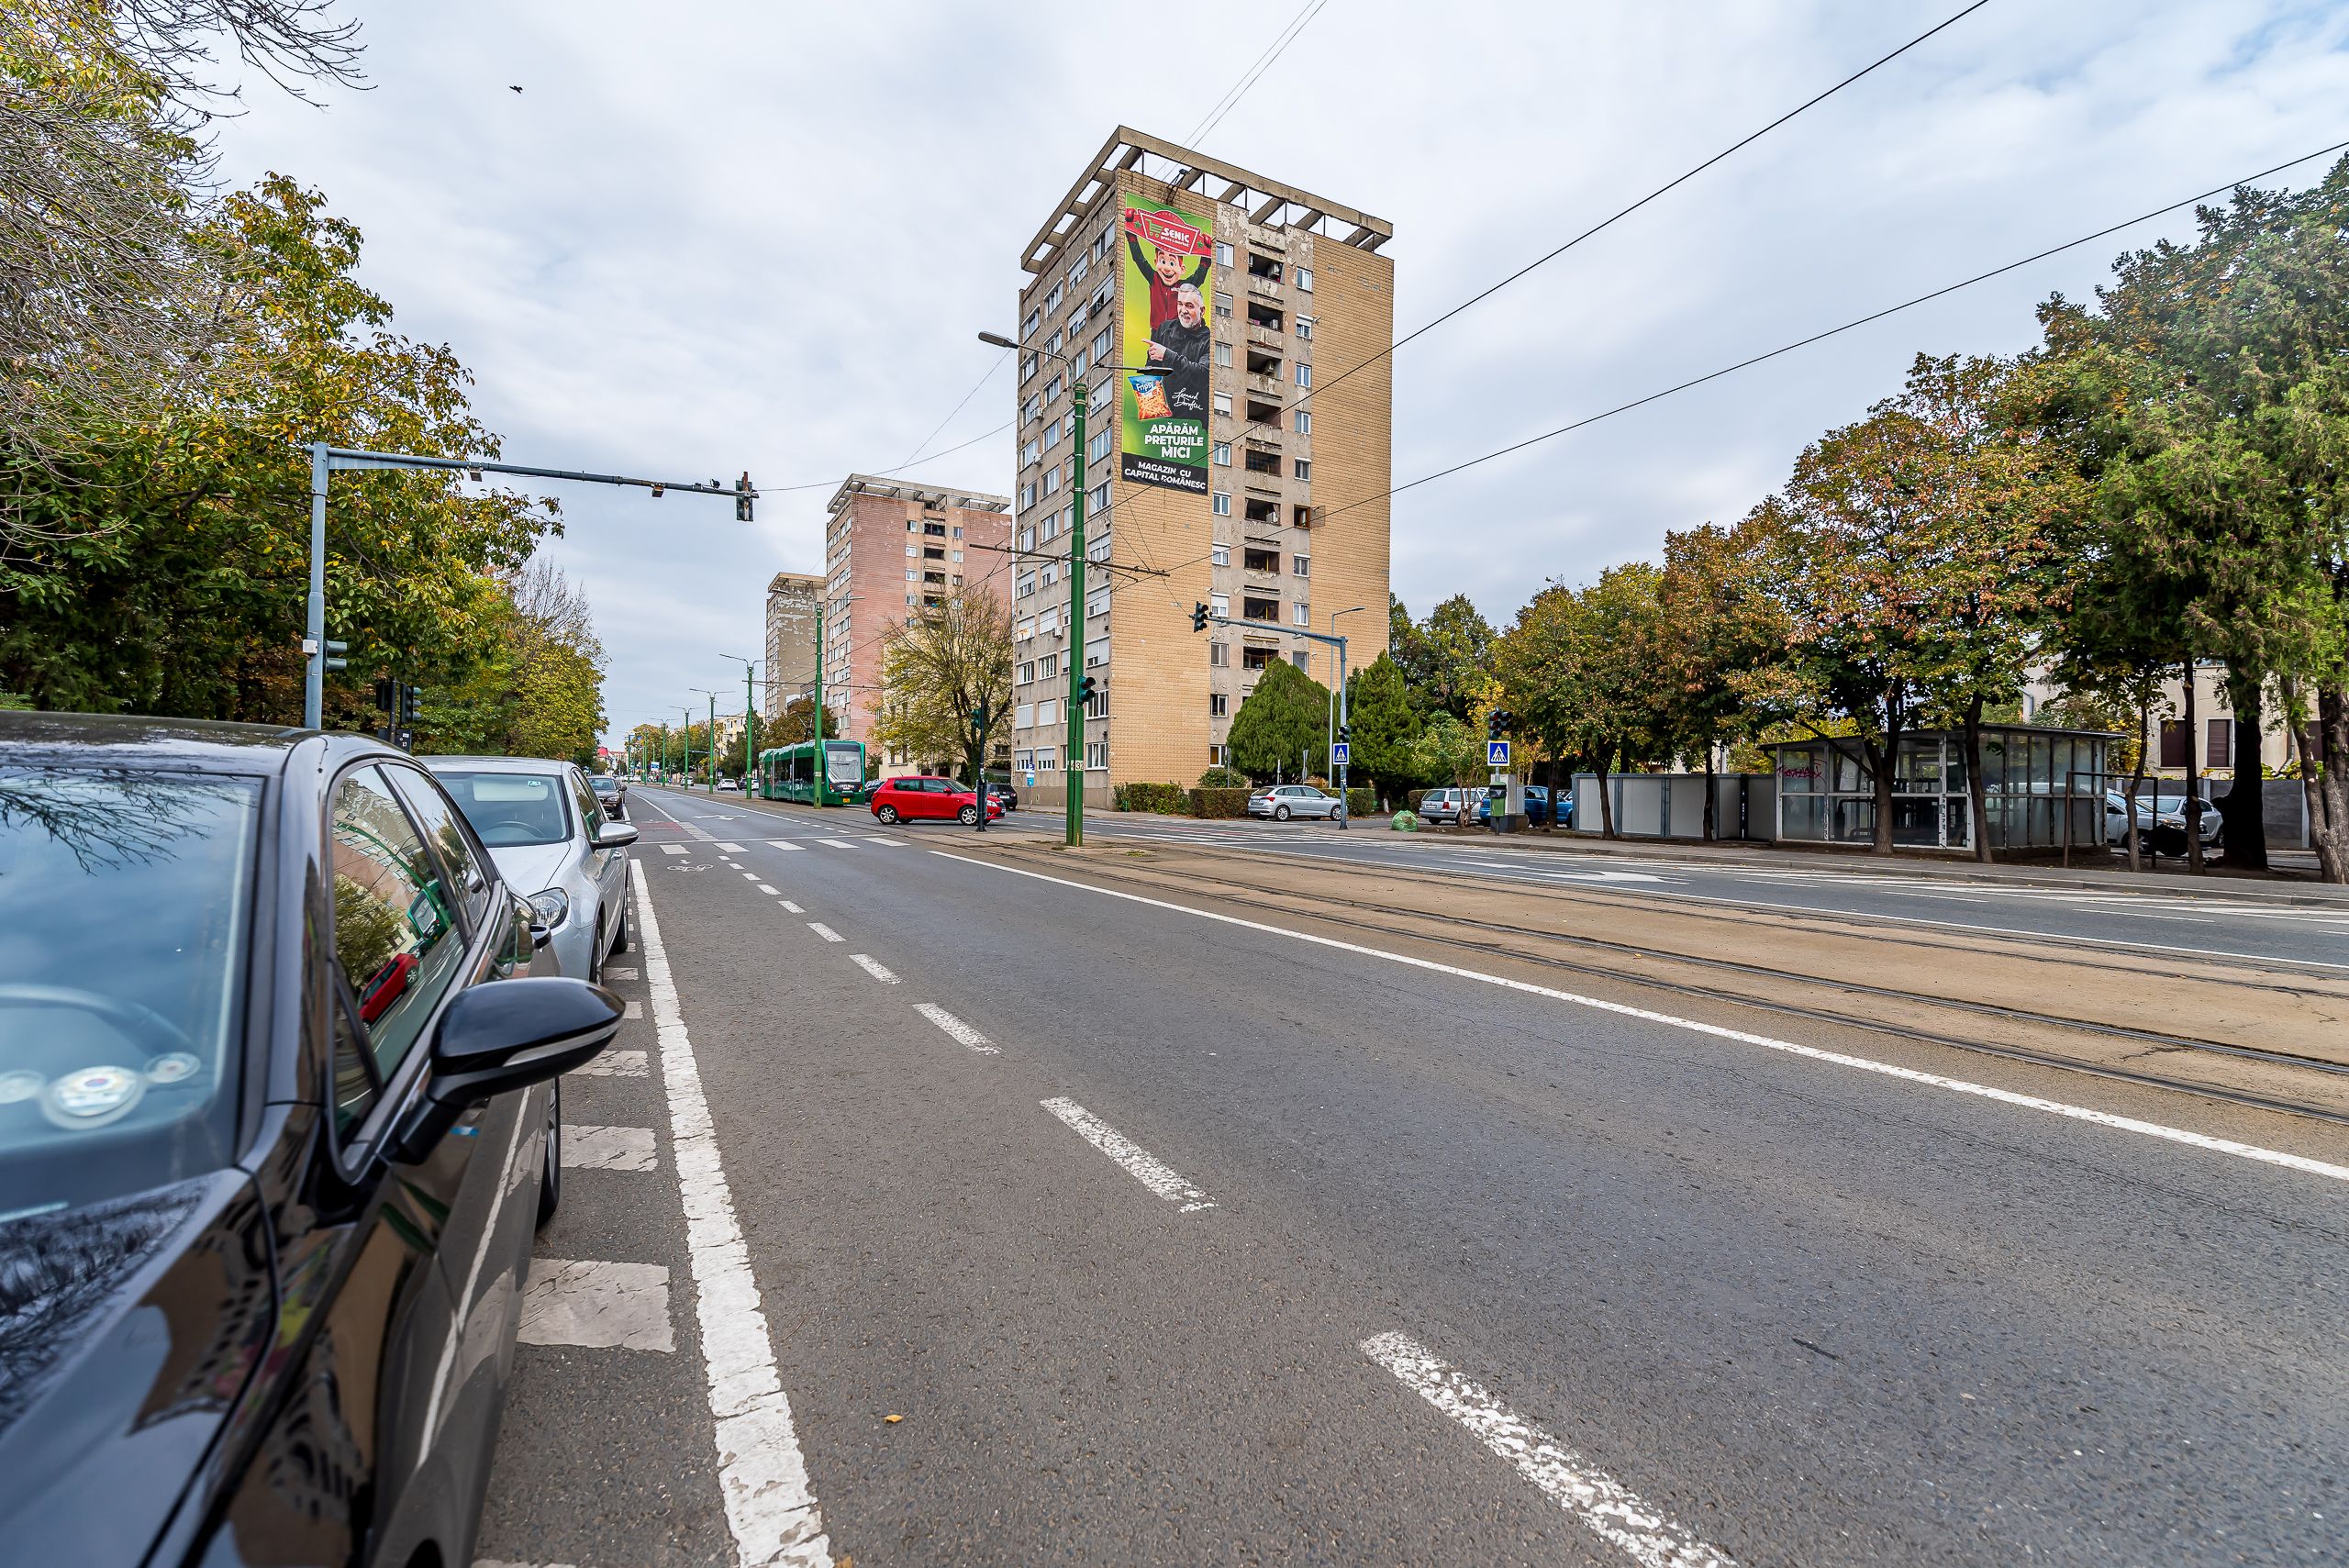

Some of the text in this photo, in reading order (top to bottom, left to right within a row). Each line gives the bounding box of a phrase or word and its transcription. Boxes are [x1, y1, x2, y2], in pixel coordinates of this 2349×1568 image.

[1161, 228, 1189, 243] SENIC
[1150, 422, 1198, 435] APĂRĂM
[1144, 435, 1204, 448] PREȚURILE
[1161, 447, 1190, 458] MICI
[1138, 461, 1191, 477] MAGAZIN CU
[1124, 468, 1206, 489] CAPITAL ROMÂNESC
